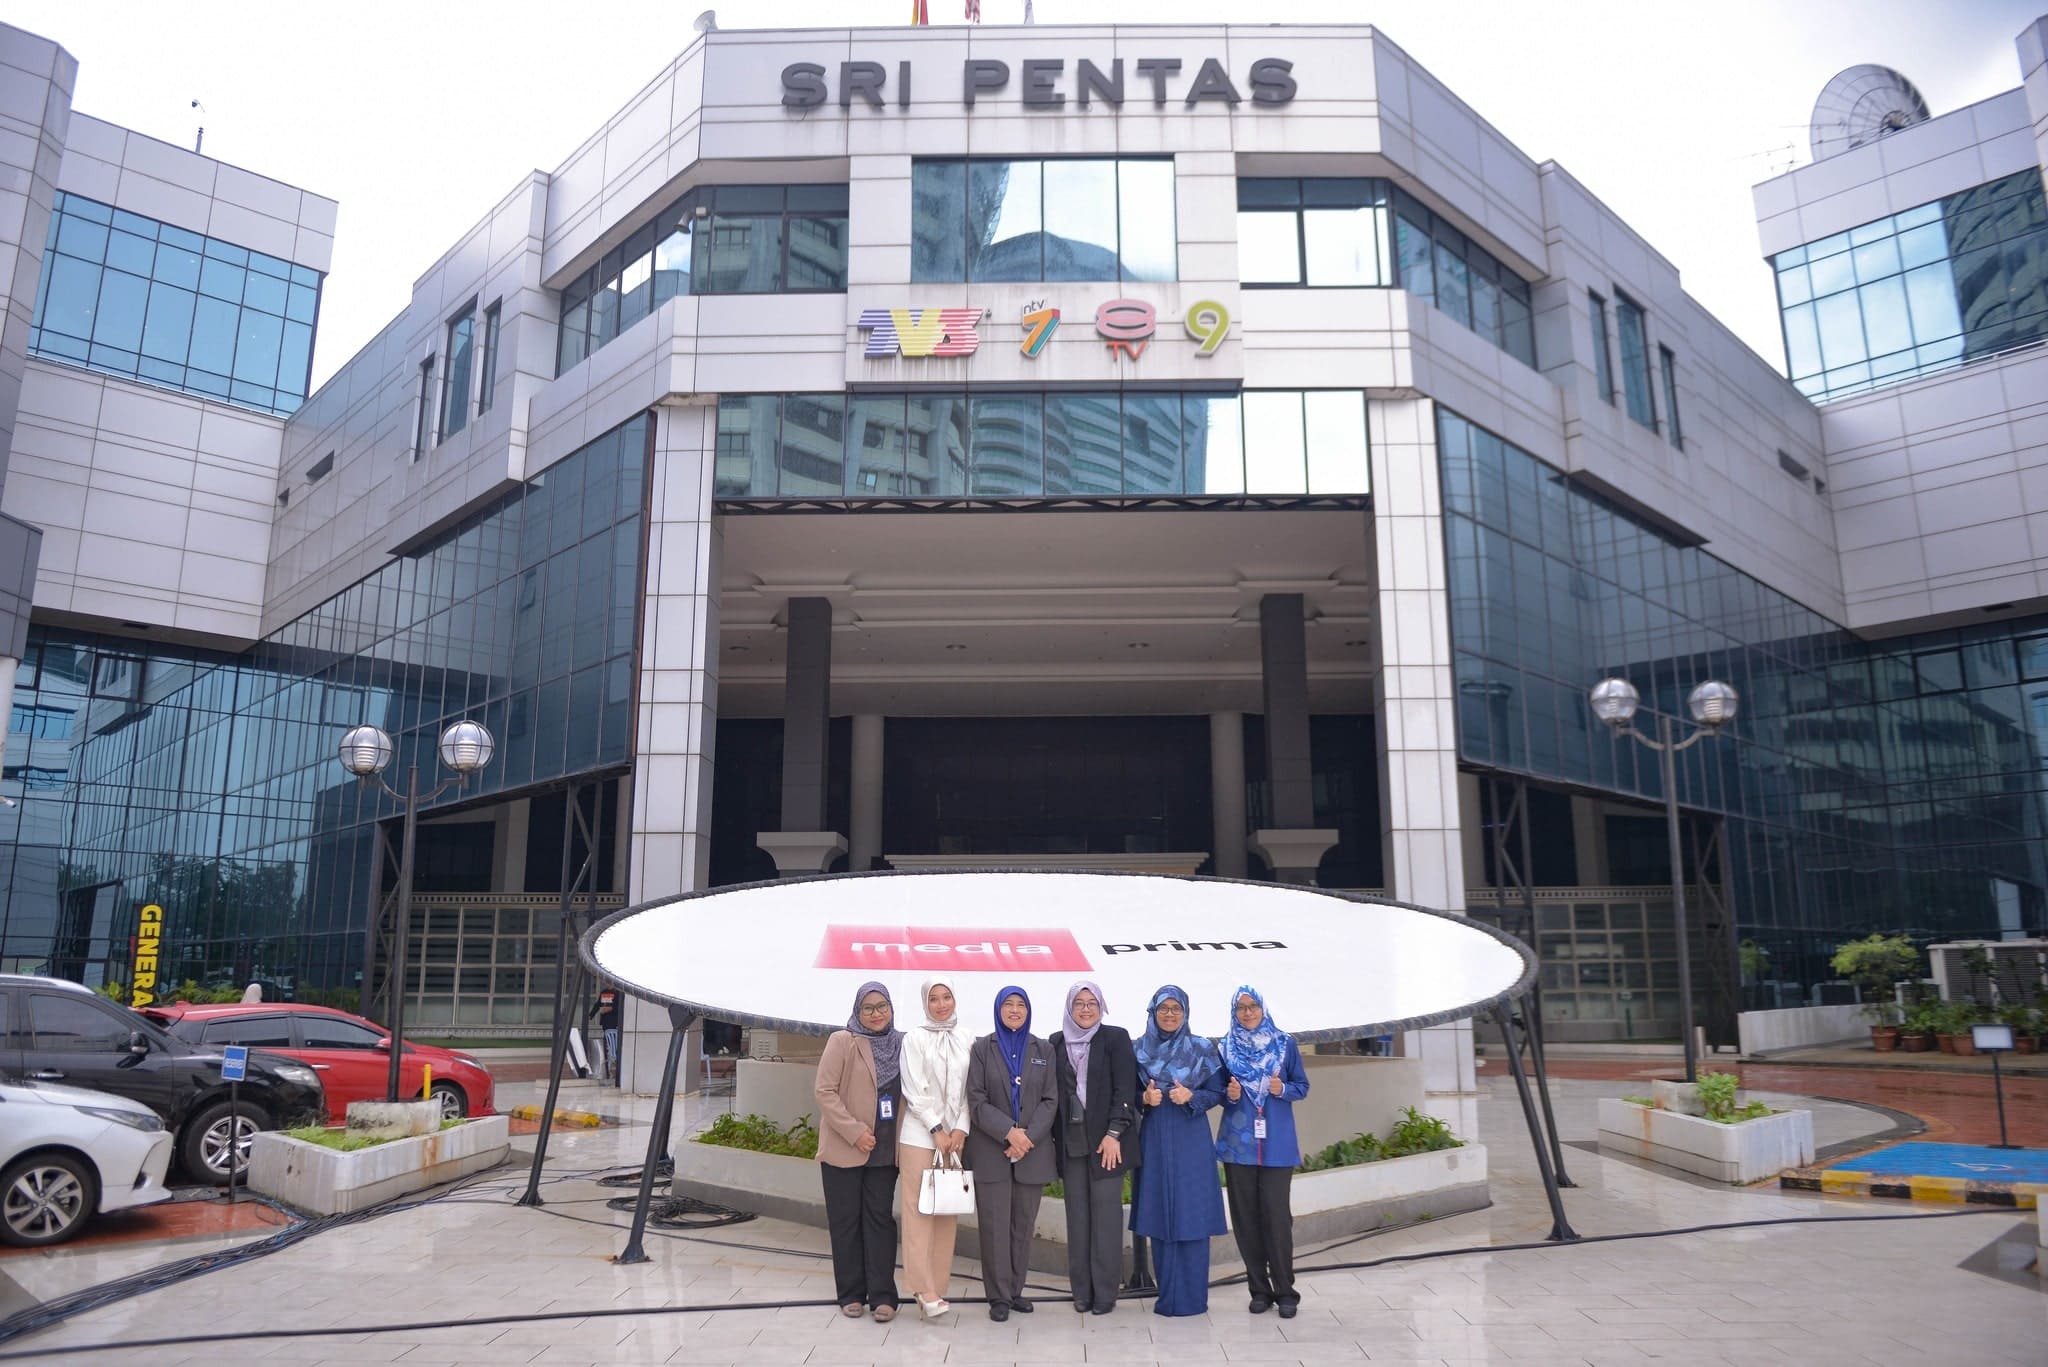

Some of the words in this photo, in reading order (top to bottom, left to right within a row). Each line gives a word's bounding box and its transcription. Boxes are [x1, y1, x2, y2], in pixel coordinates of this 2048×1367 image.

[781, 60, 911, 107] SRI
[964, 57, 1298, 107] PENTAS
[1023, 299, 1045, 315] ntv
[1186, 300, 1230, 357] 9
[857, 308, 984, 358] TV3
[1022, 308, 1061, 359] 7
[1106, 340, 1147, 361] TV
[850, 941, 1053, 955] media
[1101, 938, 1288, 955] prima
